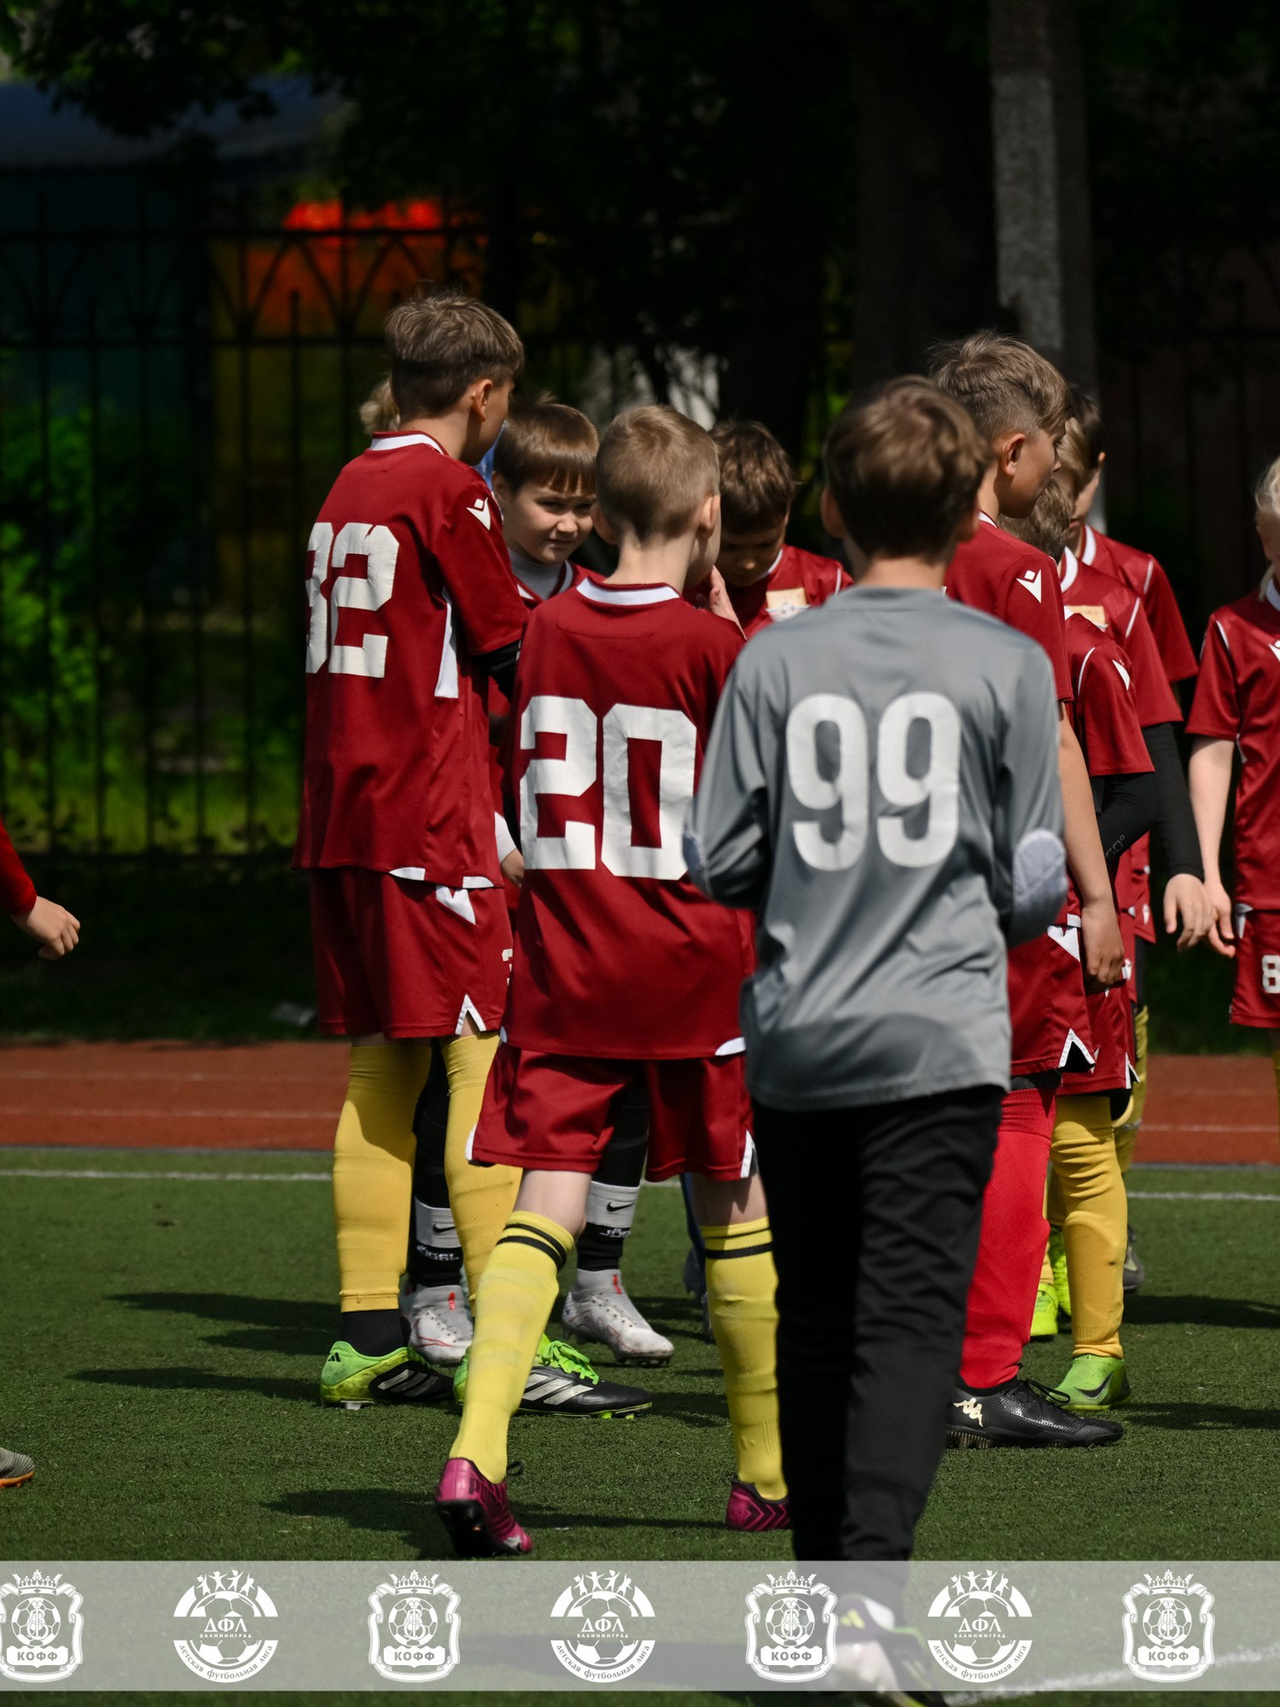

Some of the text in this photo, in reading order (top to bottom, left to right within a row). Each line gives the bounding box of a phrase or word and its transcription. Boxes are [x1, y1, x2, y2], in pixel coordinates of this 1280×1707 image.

[305, 522, 400, 678] 32
[519, 695, 697, 881] 20
[786, 692, 962, 871] 99
